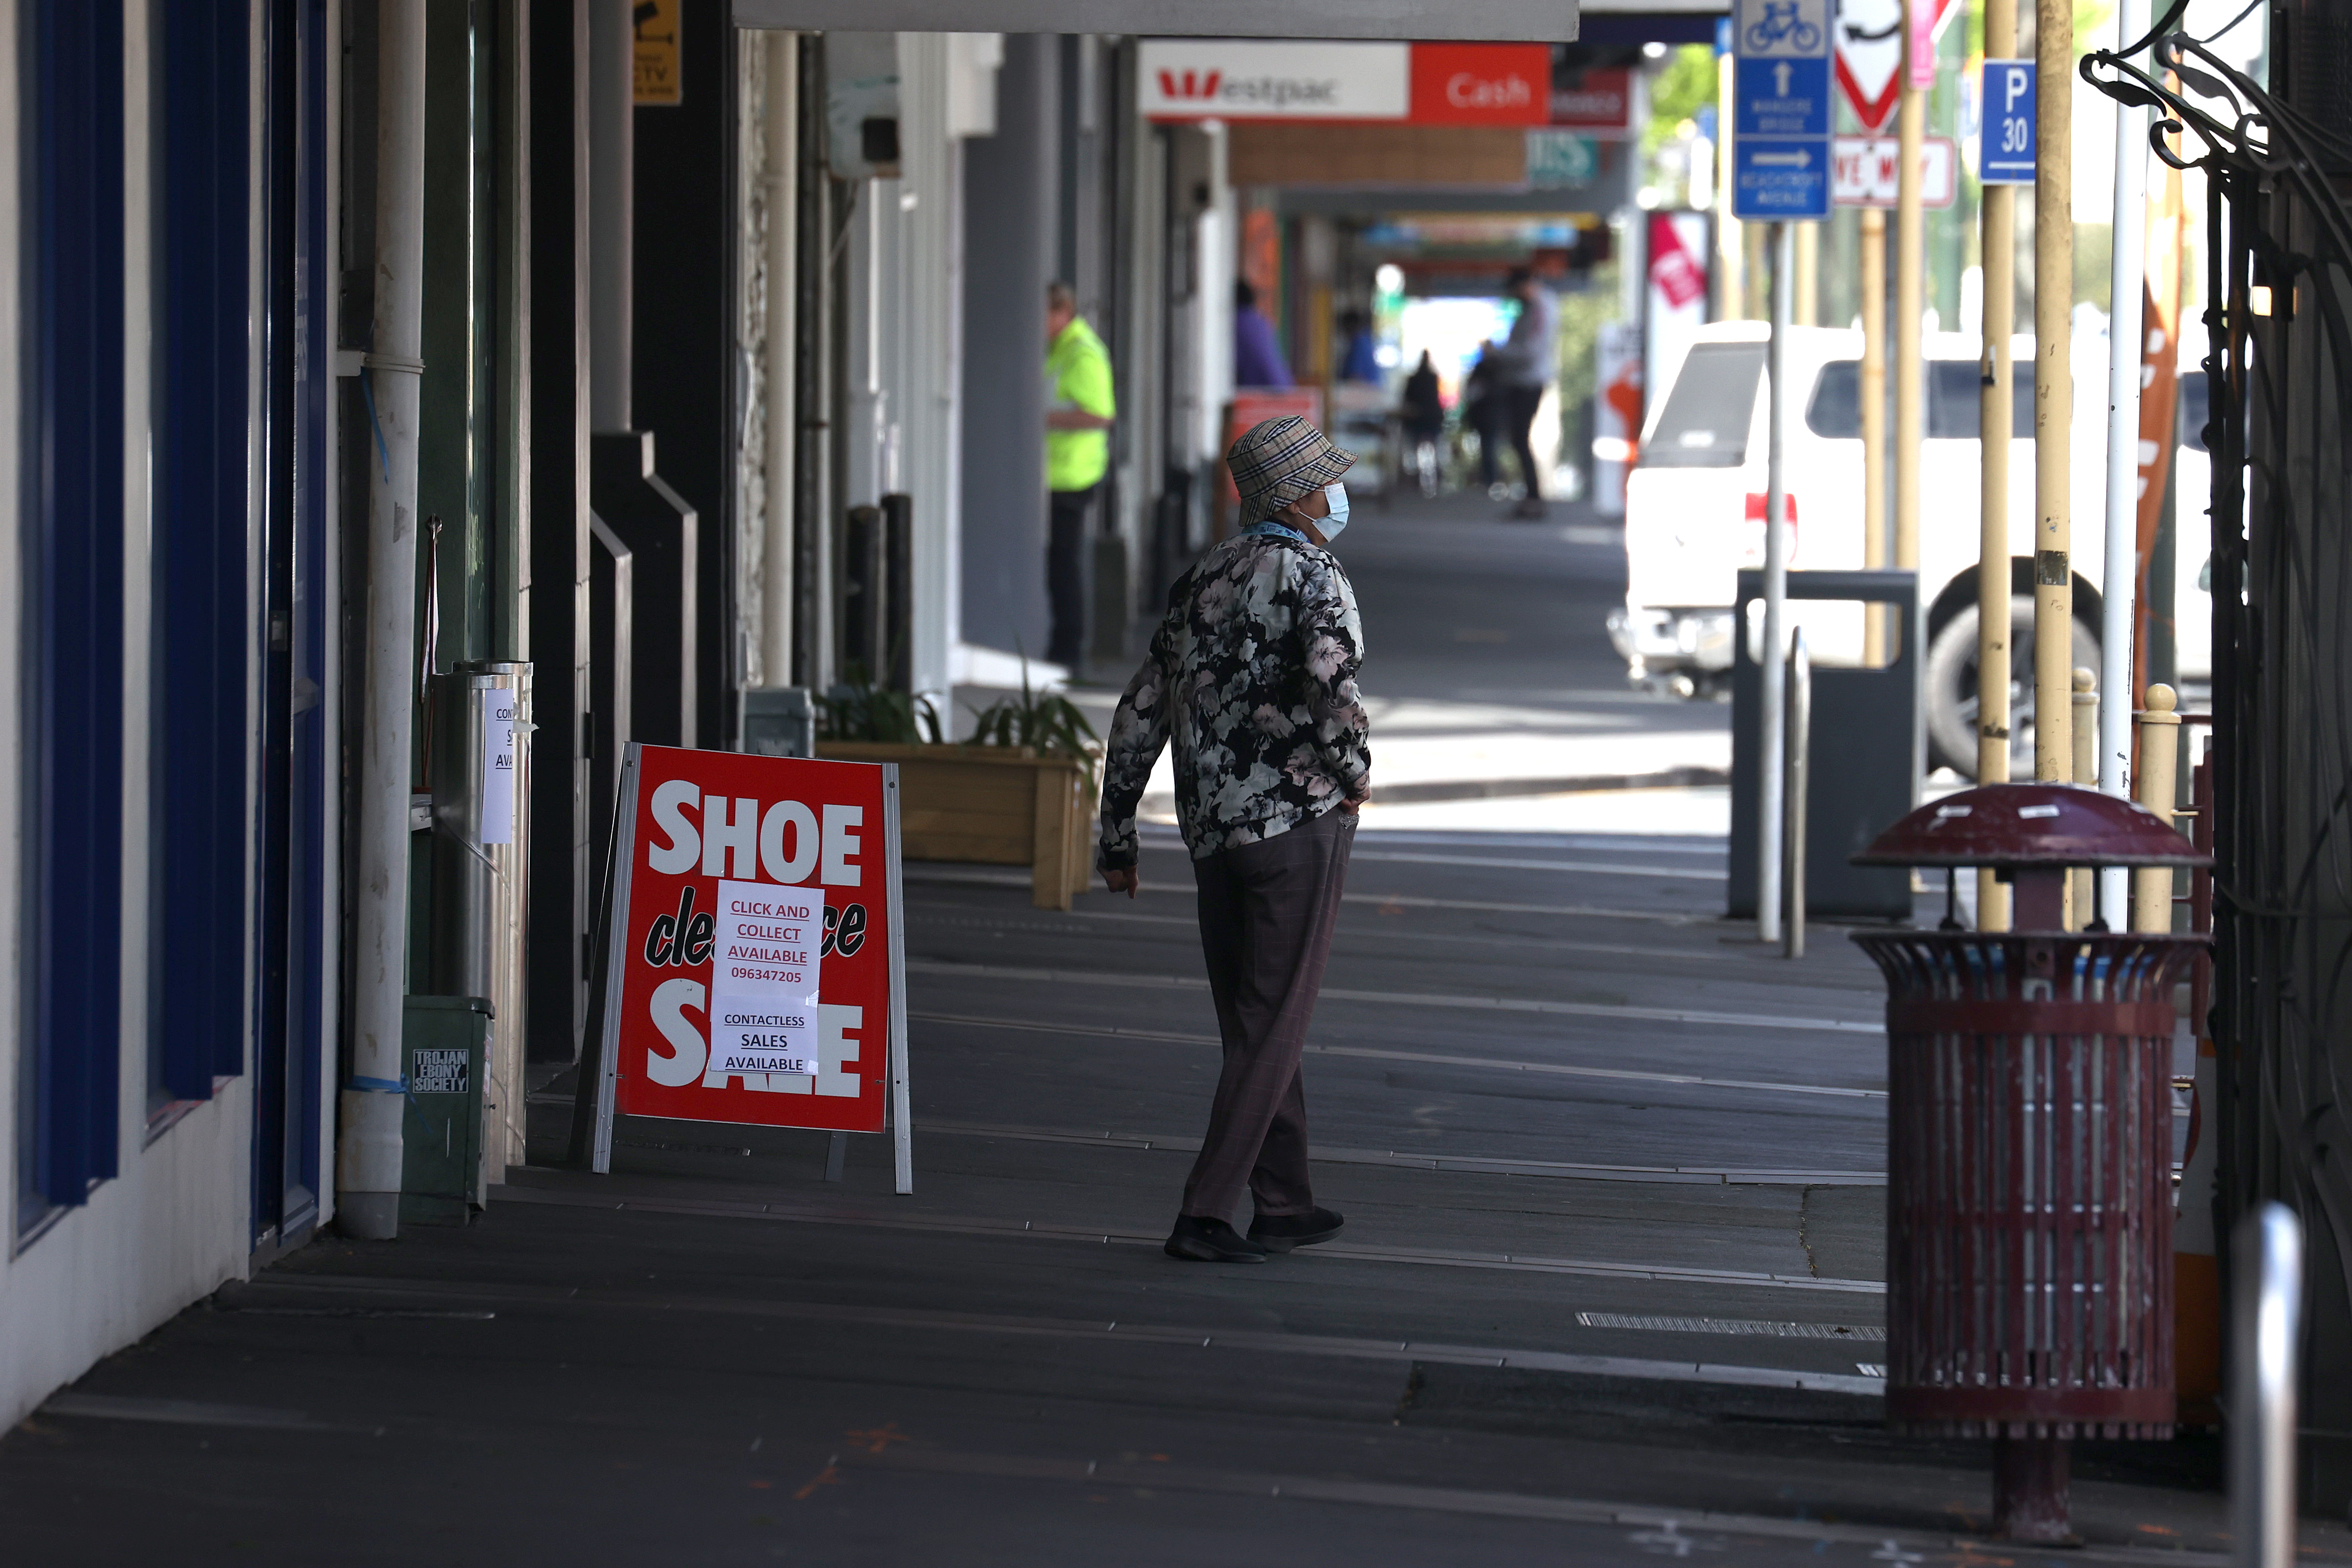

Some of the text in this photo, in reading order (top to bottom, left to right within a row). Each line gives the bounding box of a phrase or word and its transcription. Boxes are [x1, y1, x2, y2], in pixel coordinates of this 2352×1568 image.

[1157, 70, 1338, 110] Westpac
[1446, 72, 1532, 108] Cash
[2005, 68, 2028, 113] P
[2001, 117, 2028, 153] 30
[496, 708, 513, 718] CON
[648, 779, 863, 887] SHOE
[731, 900, 810, 919] CLICK AND
[644, 885, 867, 967] clece
[737, 924, 802, 940] COLLECT
[728, 945, 808, 963] AVAILABLE
[731, 967, 802, 983] 096347205
[724, 1014, 805, 1026] CONTACTLESS
[646, 978, 863, 1098] SE
[741, 1033, 788, 1048] SALES
[415, 1051, 467, 1065] TROJAN
[725, 1057, 803, 1071] AVAILABLE
[420, 1064, 462, 1078] EBONY
[415, 1077, 466, 1092] SOCIETY
